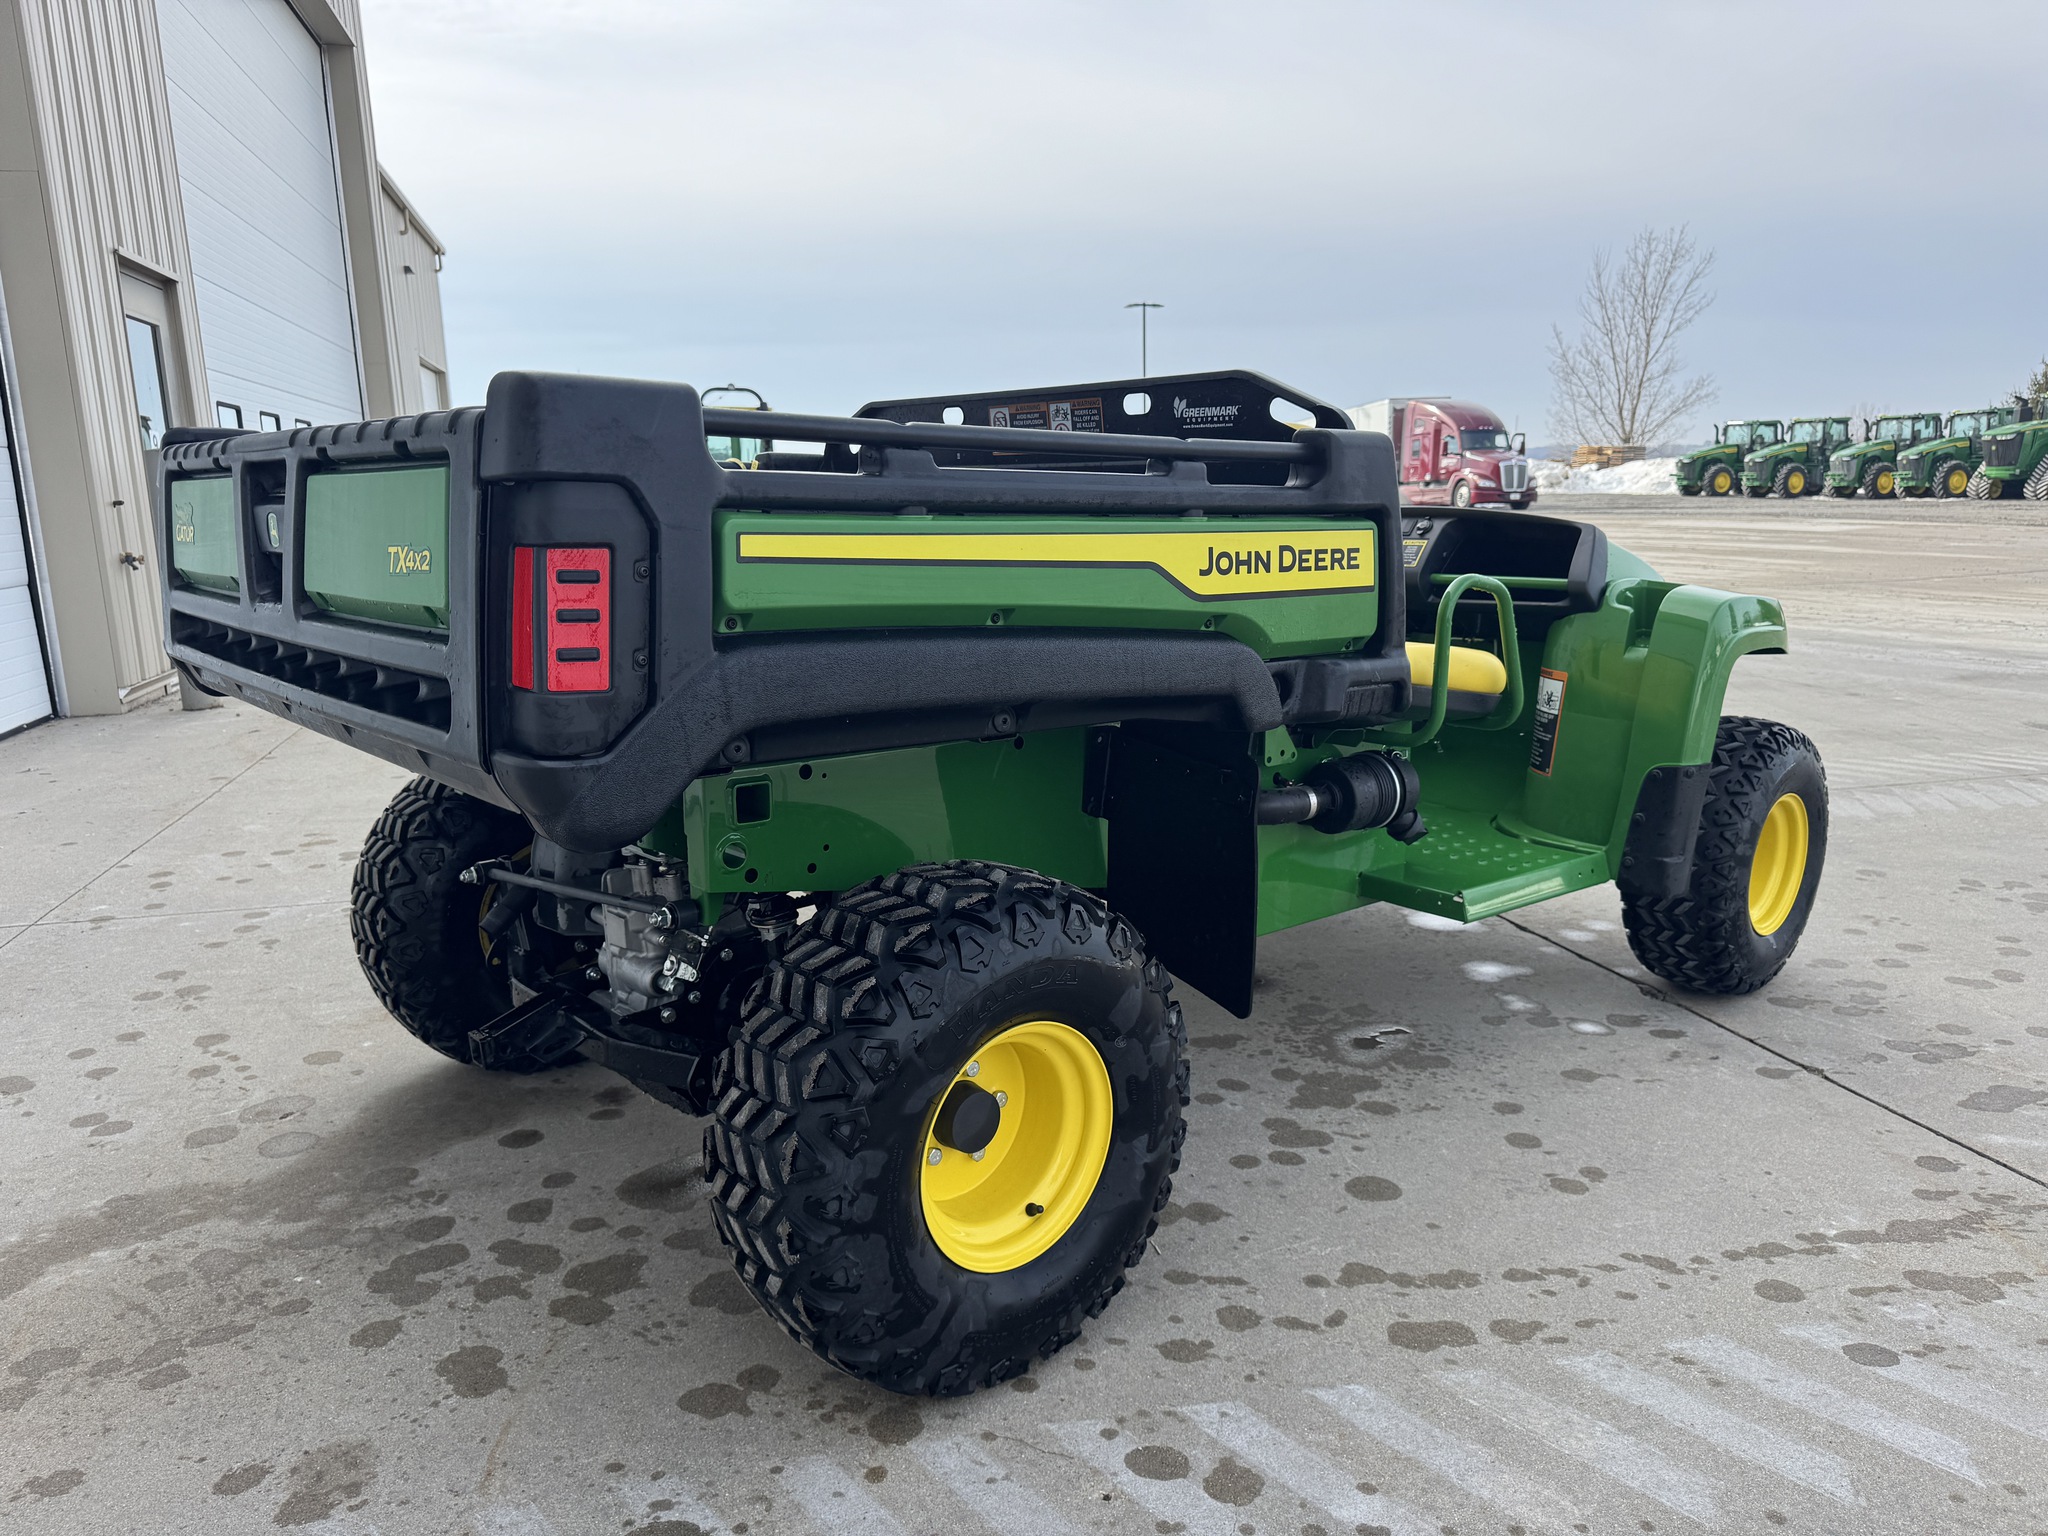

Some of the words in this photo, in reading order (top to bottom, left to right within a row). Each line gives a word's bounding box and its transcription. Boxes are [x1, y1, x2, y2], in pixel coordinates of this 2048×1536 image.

[1182, 405, 1239, 418] GREENMARK
[1186, 415, 1235, 423] EQUIPMENT
[176, 523, 194, 543] GATOR
[1198, 546, 1272, 577] JOHN
[1278, 544, 1361, 573] DEERE
[949, 964, 1079, 1039] WANDA
